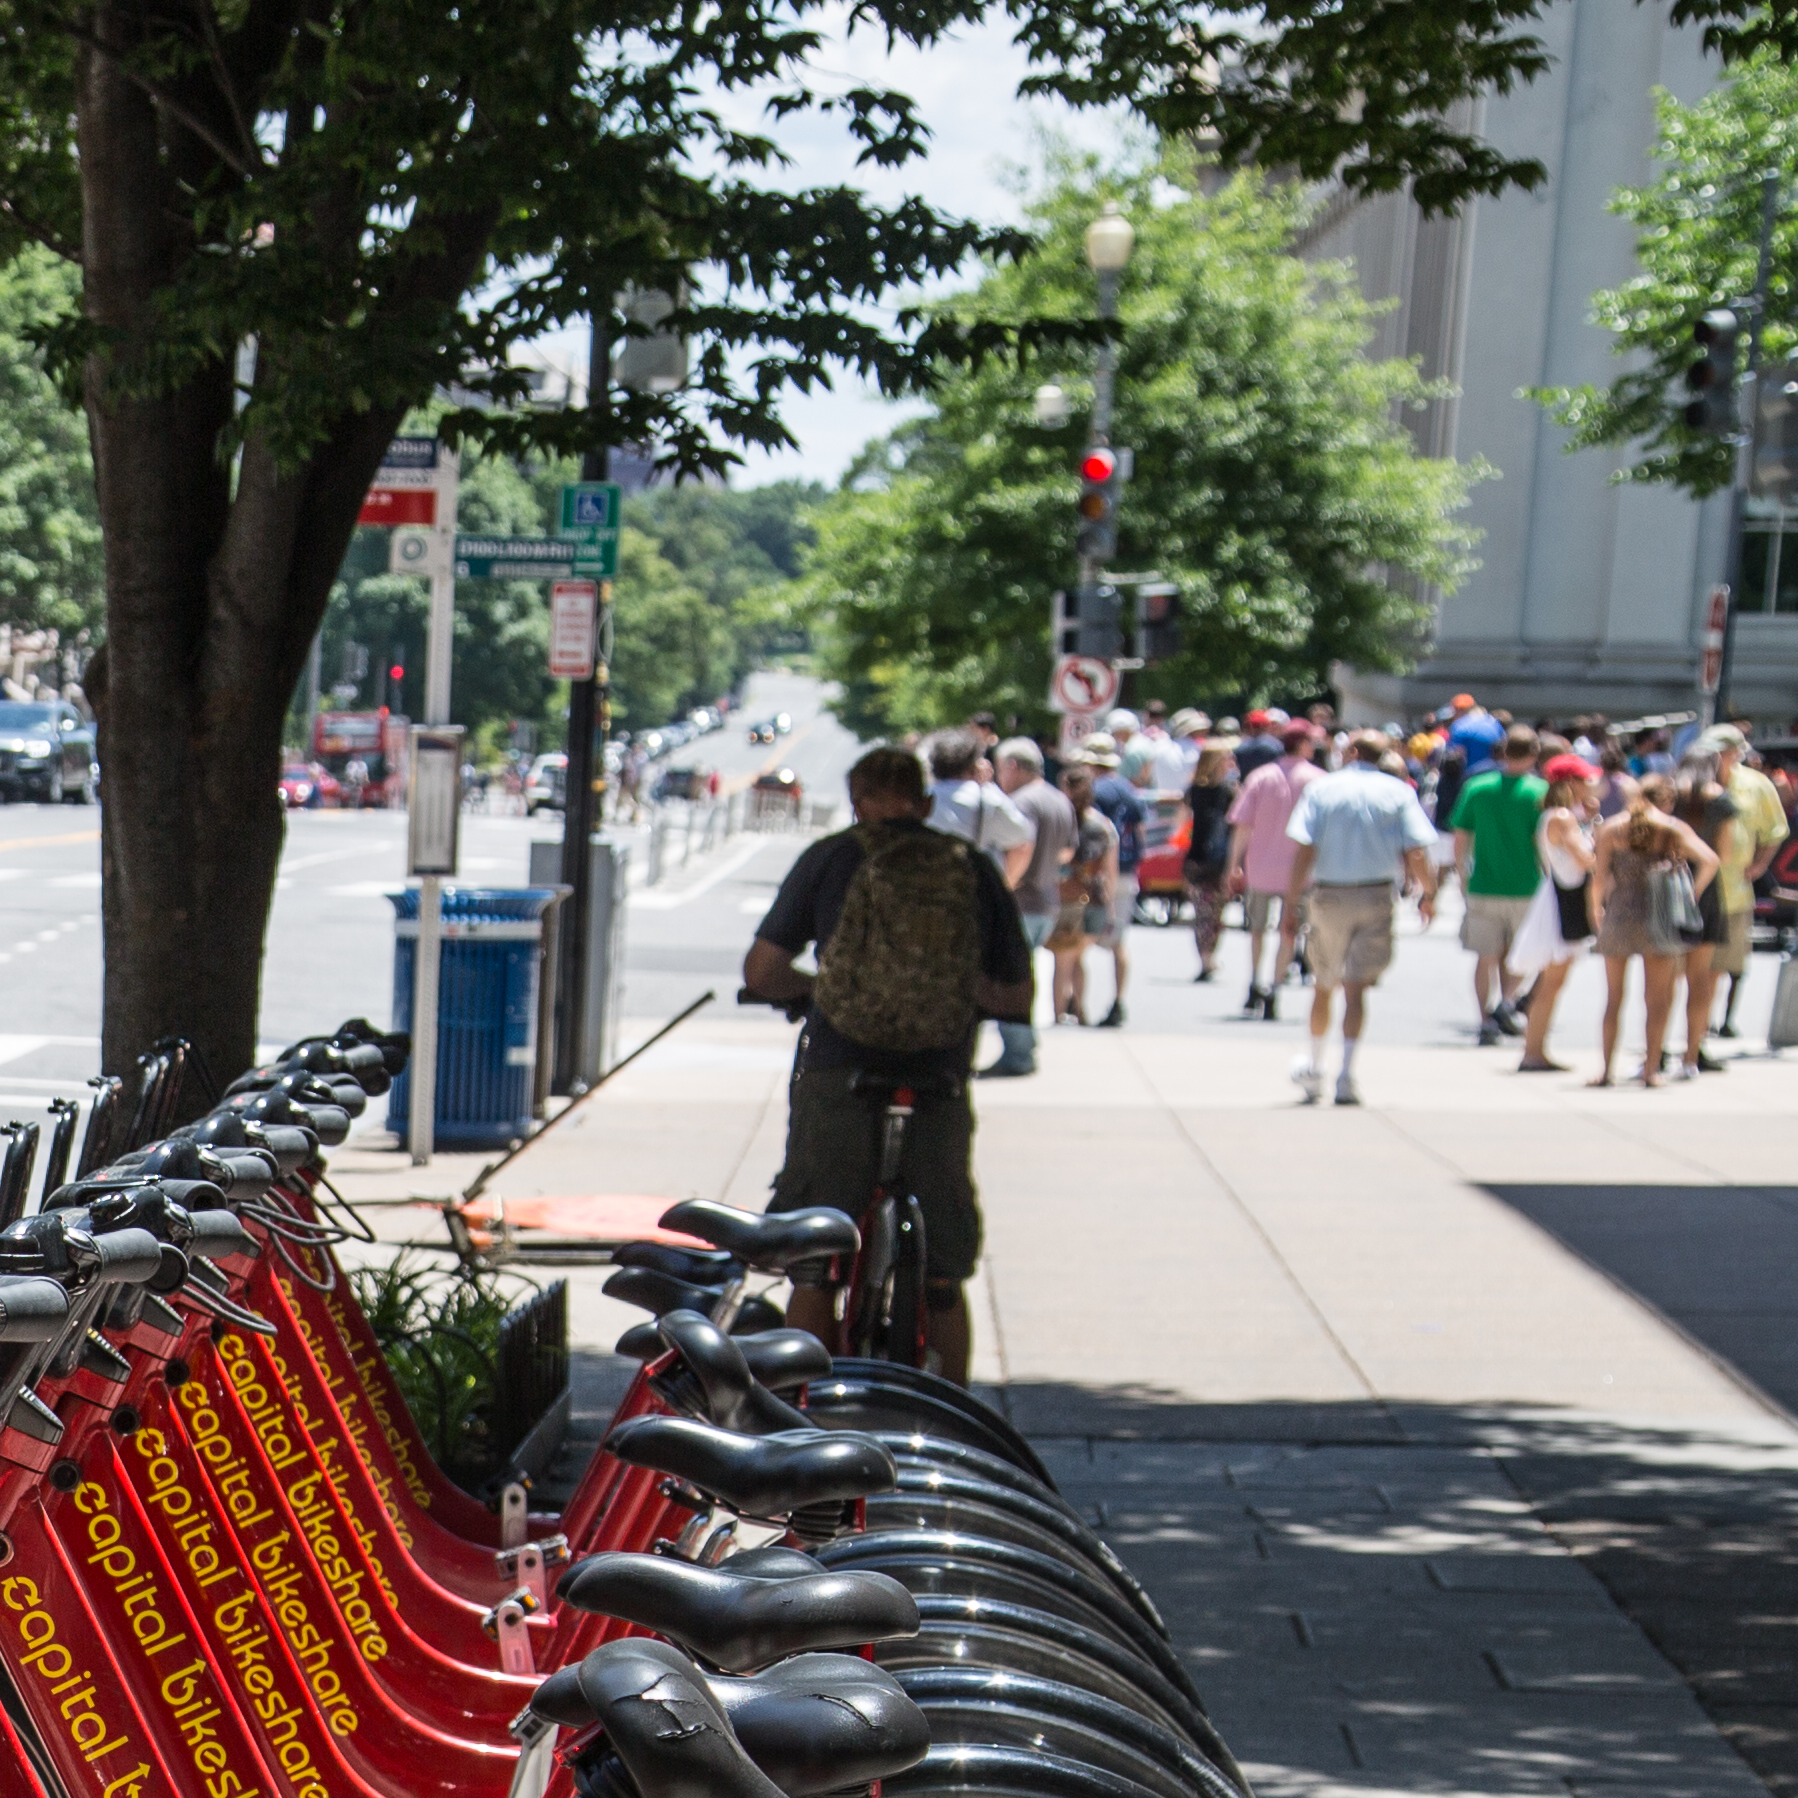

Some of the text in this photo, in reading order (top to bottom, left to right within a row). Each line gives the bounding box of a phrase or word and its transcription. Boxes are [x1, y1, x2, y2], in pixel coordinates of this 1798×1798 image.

[75, 1484, 186, 1656] capital
[136, 1428, 237, 1587] capital
[180, 1382, 358, 1736] capital bikeshare
[219, 1334, 387, 1662] capital bikeshare
[3, 1577, 128, 1762] capital
